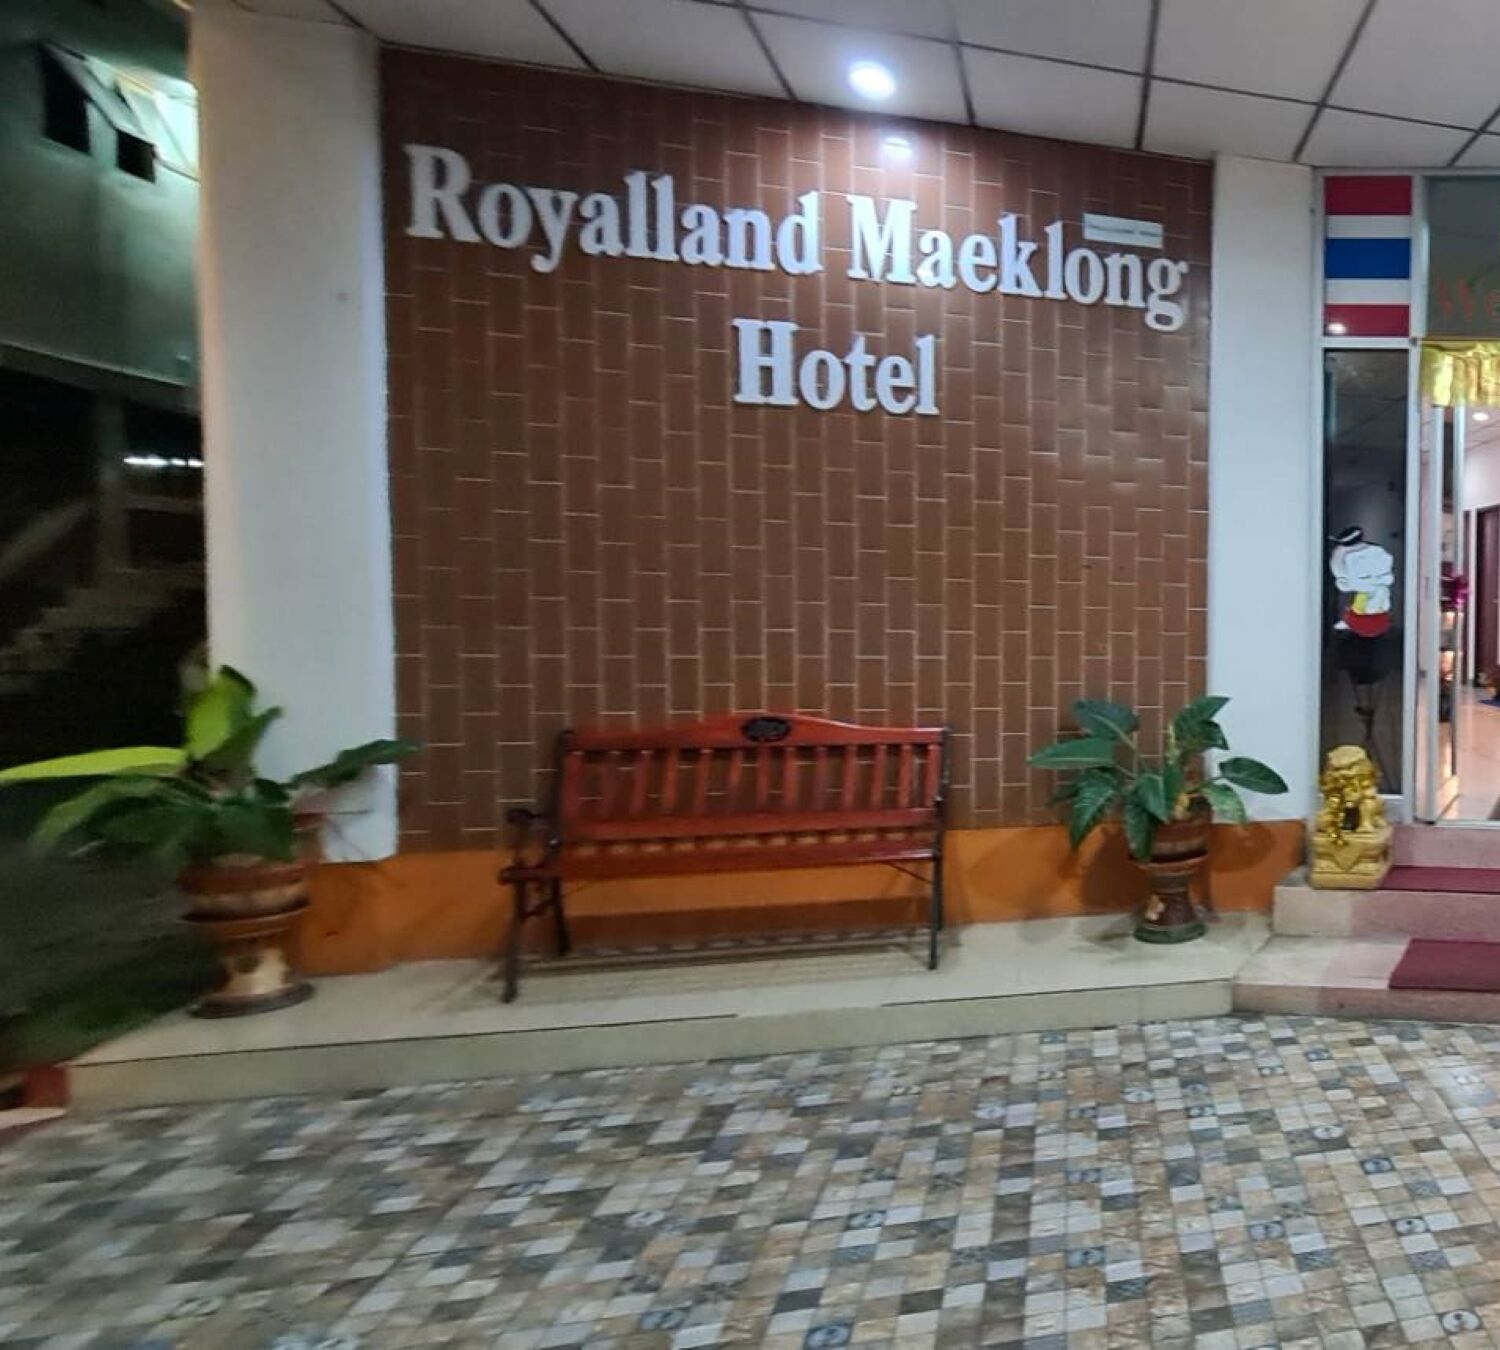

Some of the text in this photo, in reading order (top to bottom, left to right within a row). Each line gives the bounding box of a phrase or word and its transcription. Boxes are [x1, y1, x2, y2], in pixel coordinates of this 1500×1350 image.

[403, 144, 1189, 333] Royalland Maeklong
[732, 318, 940, 416] Hotel
